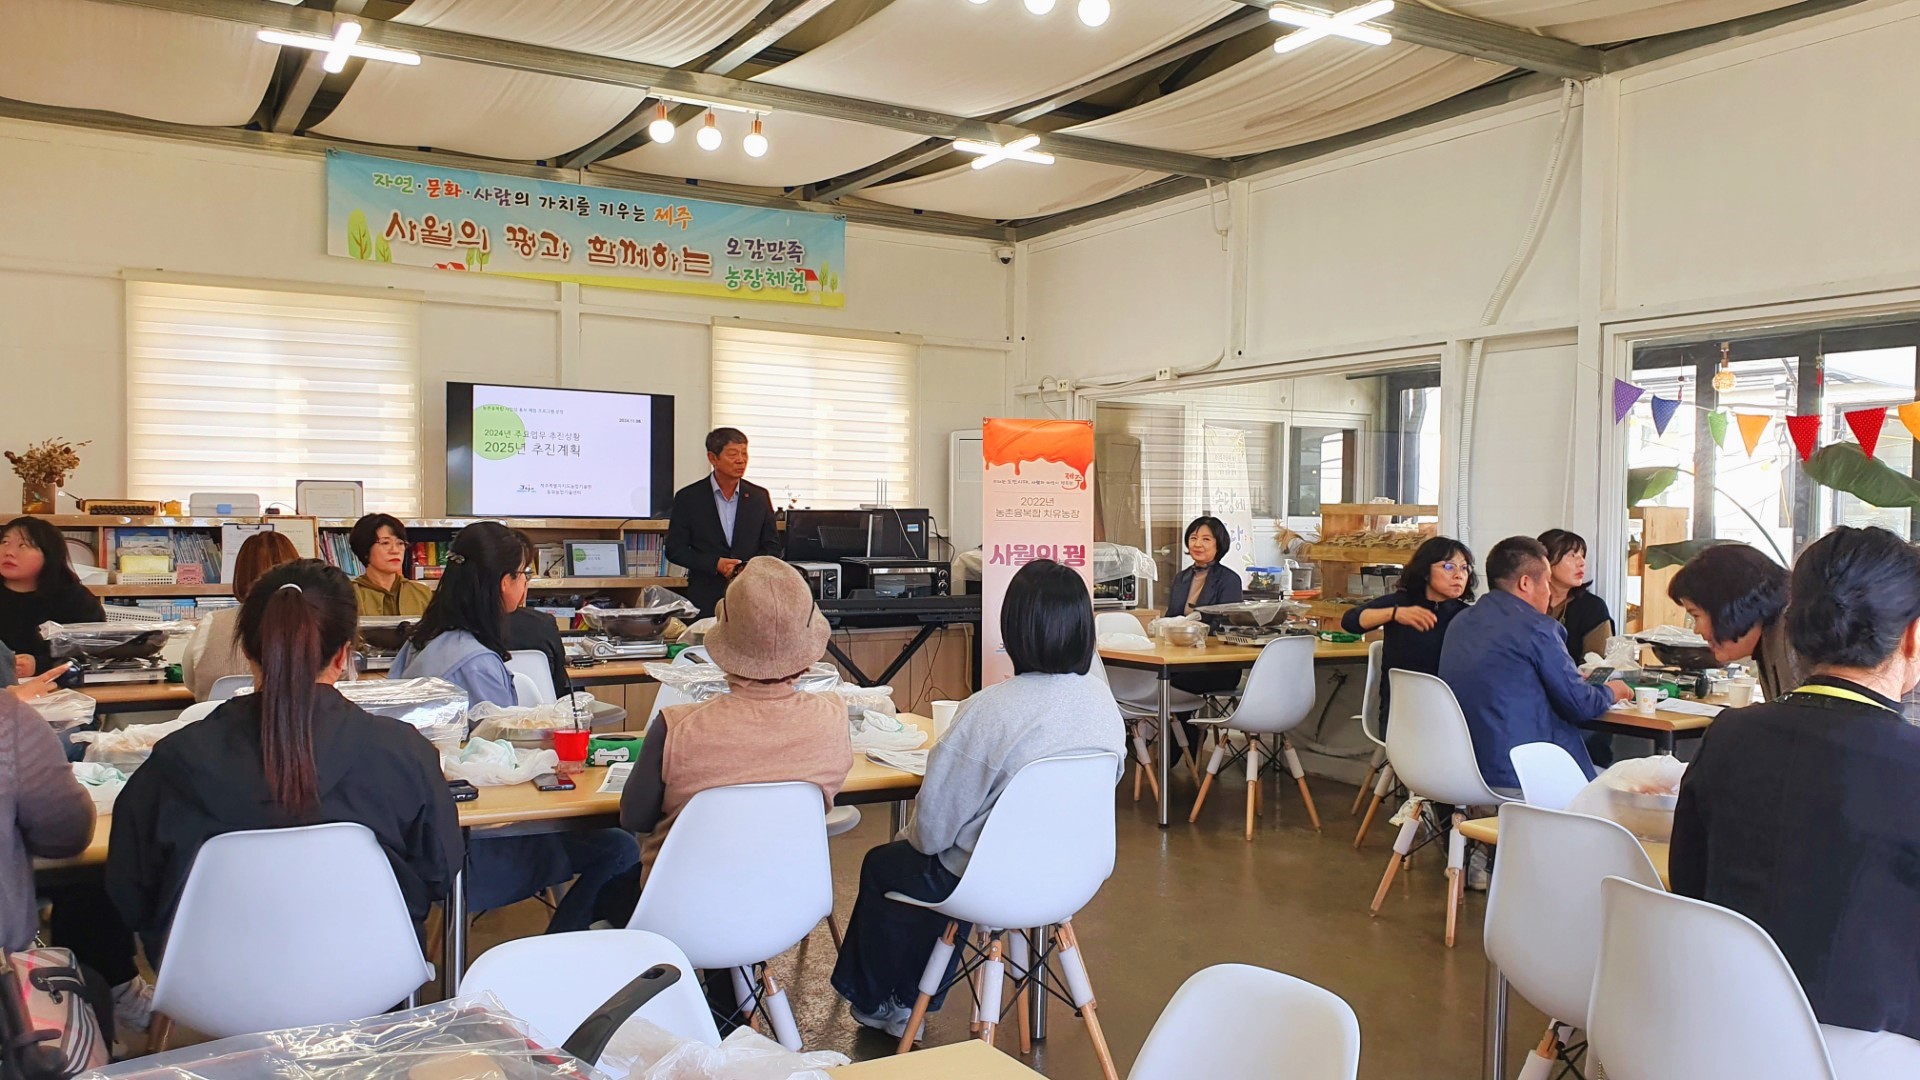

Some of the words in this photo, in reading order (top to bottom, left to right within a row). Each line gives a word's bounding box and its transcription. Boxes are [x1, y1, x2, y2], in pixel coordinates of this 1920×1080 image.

[538, 196, 590, 217] 가치를
[599, 202, 645, 222] 키우는
[653, 205, 693, 230] 제주
[385, 212, 489, 250] 사월의
[505, 225, 570, 260] 꿩과
[587, 235, 711, 275] 함께하는
[726, 237, 805, 263] 오감만족
[725, 265, 806, 292] 농장체험
[484, 429, 511, 439] 2024년
[514, 430, 546, 439] 주요업무
[549, 431, 580, 442] 추진상황
[484, 441, 526, 455] 2025년
[531, 442, 581, 457] 추진계획
[995, 508, 1041, 518] 농촌융복합
[1043, 509, 1080, 519] 치유농장
[1020, 496, 1055, 507] 2022년
[1215, 487, 1246, 514] 송당에
